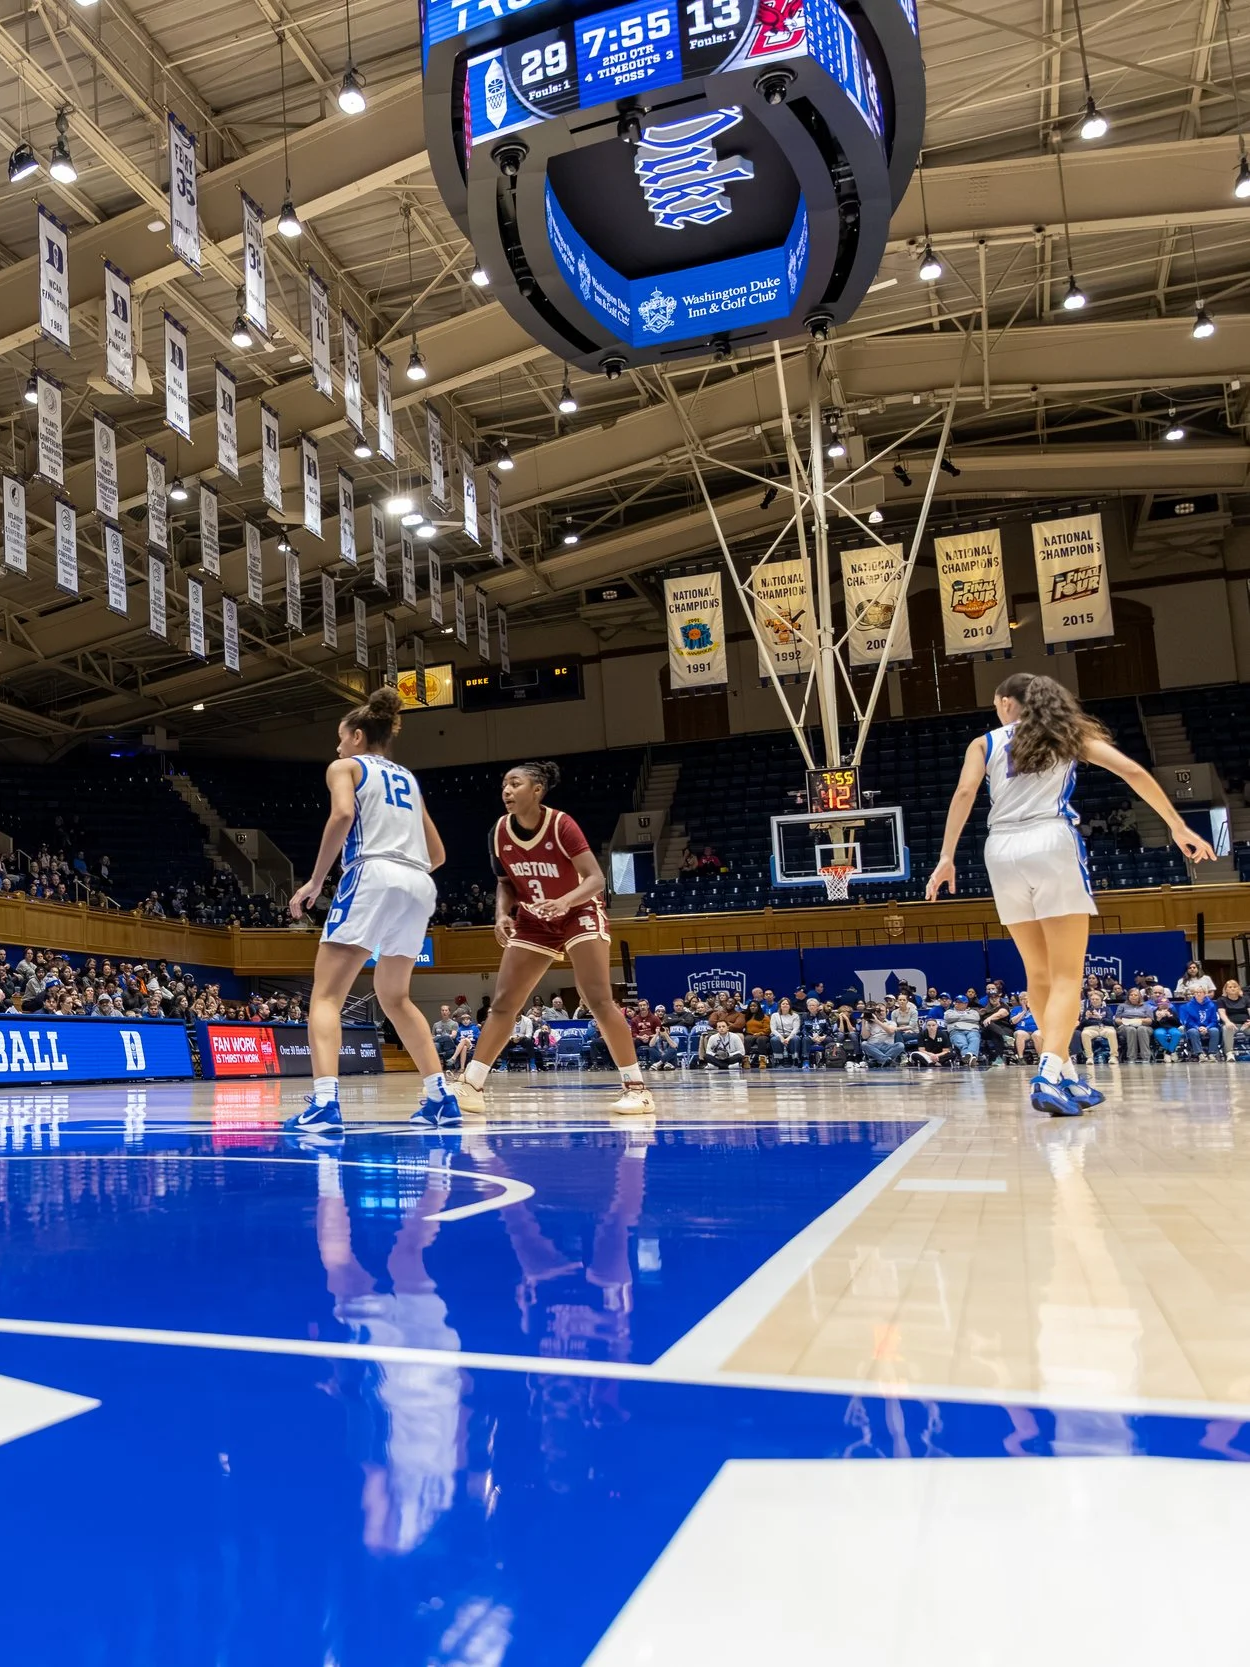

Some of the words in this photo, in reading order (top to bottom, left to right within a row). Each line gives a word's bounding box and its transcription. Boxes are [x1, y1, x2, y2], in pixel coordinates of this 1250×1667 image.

[686, 0, 741, 36] 13
[583, 9, 671, 58] 7:55
[689, 34, 728, 50] Fouls:
[521, 40, 567, 86] 29
[602, 52, 626, 66] 2ND
[629, 44, 654, 60] QTR
[585, 73, 593, 82] 4
[597, 54, 661, 79] TIMEOUTS
[666, 50, 674, 61] 3
[614, 69, 645, 85] POSS
[528, 84, 562, 101] Fouls:
[176, 167, 196, 207] 35
[48, 279, 62, 295] NCAA
[682, 284, 748, 306] Washington
[750, 276, 781, 294] Duke
[688, 306, 707, 318] Inn
[709, 304, 720, 315] &
[721, 296, 747, 313] Golf
[114, 327, 127, 343] NCAA
[1043, 529, 1094, 547] NATIONAL
[945, 545, 992, 561] NATIONAL
[1039, 542, 1101, 561] CHAMPIONS
[851, 559, 895, 574] NATIONAL
[941, 557, 1000, 575] CHAMPIONS
[761, 573, 804, 588] NATIONAL
[673, 587, 714, 601] NATIONAL
[668, 598, 720, 614] CHAMPIONS
[1062, 613, 1094, 626] 2015
[963, 625, 993, 639] 2010
[866, 639, 888, 650] 200
[774, 650, 801, 663] 1992
[554, 667, 568, 676] BC
[686, 662, 711, 674] 1991
[466, 677, 489, 687] DUKE
[822, 771, 854, 784] 7:55
[1177, 772, 1190, 782] 10
[381, 769, 413, 811] 12
[828, 786, 850, 809] 12
[509, 861, 560, 878] BOSTON
[528, 879, 545, 903] 3
[693, 980, 742, 994] SISTERHOOD
[213, 1037, 231, 1052] FAN
[231, 1036, 258, 1052] WORK
[280, 1046, 291, 1055] Over
[216, 1055, 221, 1063] IS
[221, 1054, 244, 1064] THIRSTY
[243, 1054, 260, 1063] WORK
